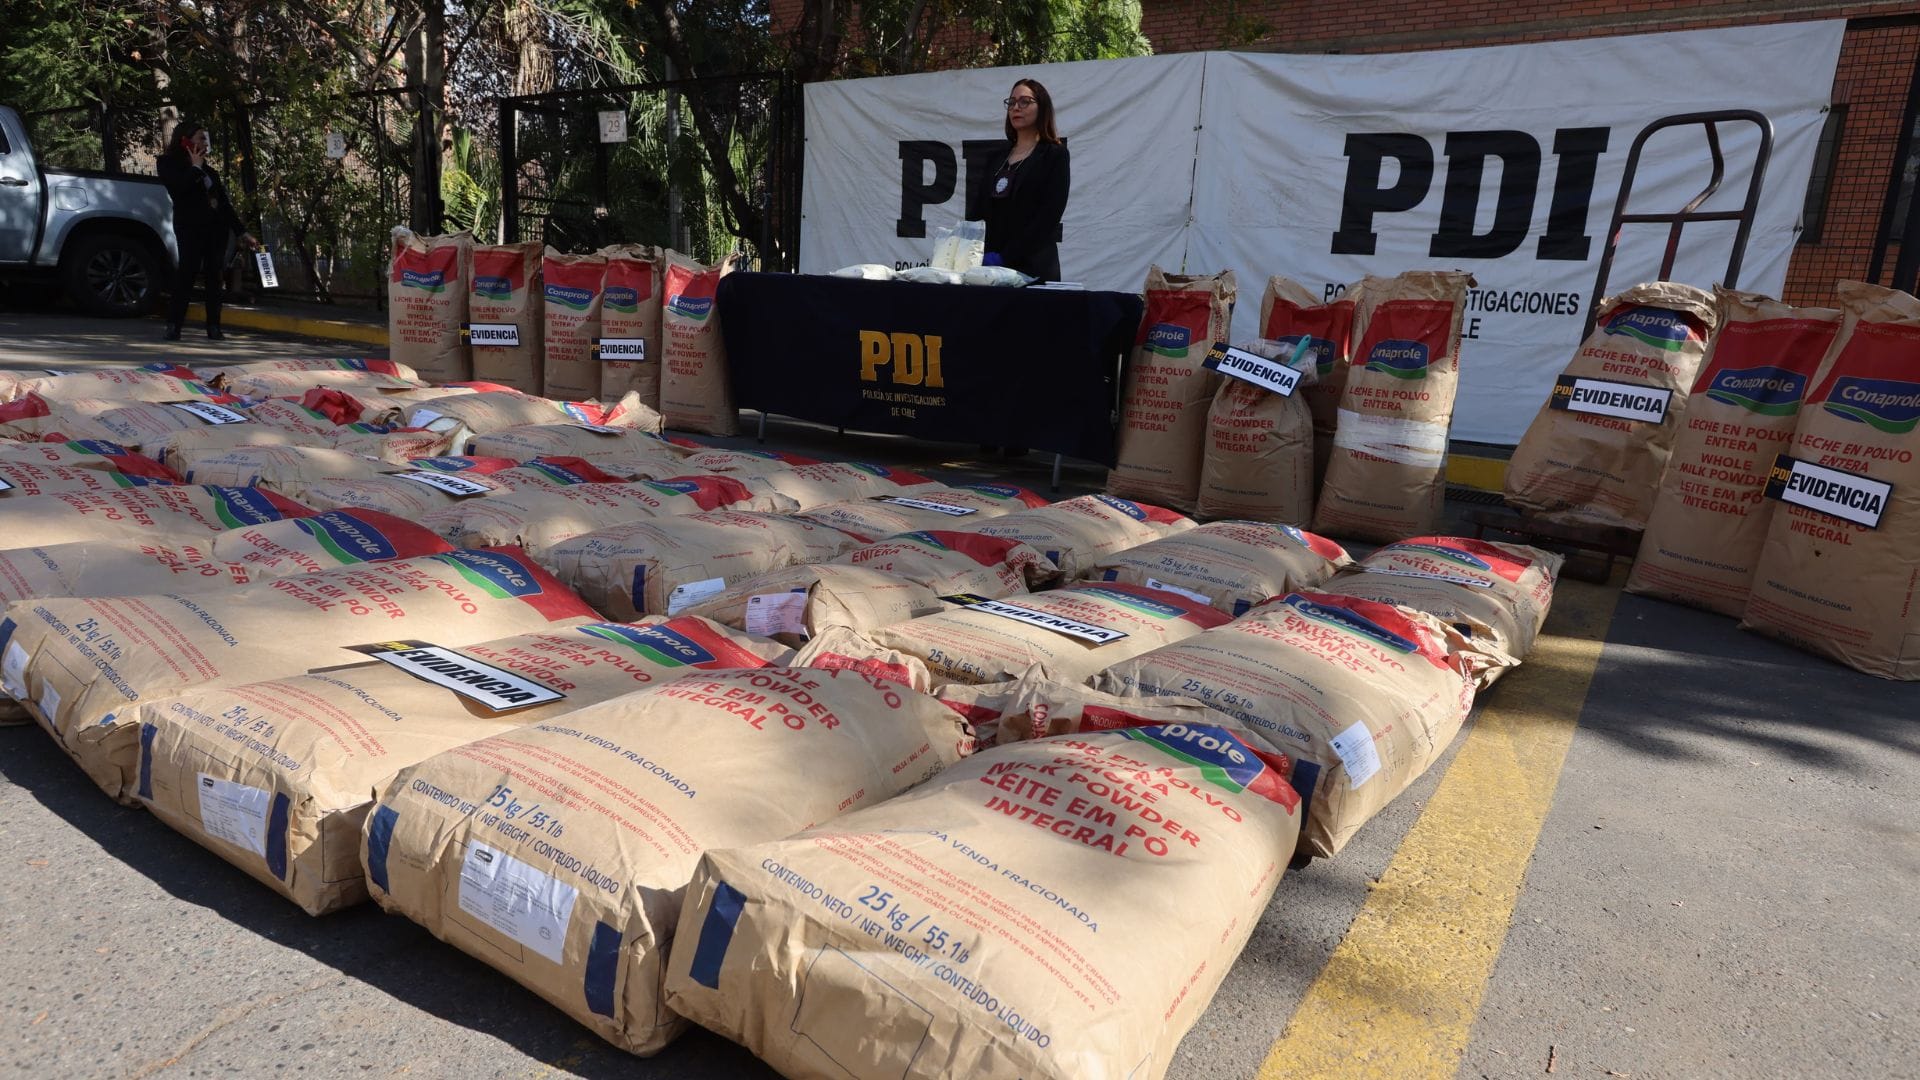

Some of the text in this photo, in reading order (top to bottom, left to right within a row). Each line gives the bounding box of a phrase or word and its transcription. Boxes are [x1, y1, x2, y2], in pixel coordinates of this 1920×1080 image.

[608, 119, 620, 132] 29
[1330, 126, 1610, 260] PDI
[260, 253, 276, 285] EVIDENCIA
[548, 287, 590, 300] Conaprole
[407, 313, 433, 321] WHOLE
[403, 336, 437, 344] INTEGRAL
[471, 330, 517, 340] EVIDENCIA
[600, 344, 643, 354] EVIDENCIA
[859, 329, 945, 389] PDI
[1583, 348, 1681, 376] LECHE EN POLVO
[1160, 367, 1193, 378] POLVO
[1222, 354, 1294, 389] EVIDENCIA
[1602, 362, 1649, 379] ENTERA
[1375, 388, 1389, 398] EN
[1392, 390, 1430, 401] POLVO
[1720, 375, 1796, 393] Conaprole
[1143, 400, 1184, 410] POWDER
[1362, 399, 1402, 411] ENTERA
[1554, 383, 1663, 414] PDI EVIDENCIA
[891, 407, 917, 419] DE CHILE
[1146, 413, 1160, 422] EM
[1575, 414, 1633, 433] INTEGRAL
[1232, 433, 1249, 442] EM
[1688, 419, 1741, 436] LECHE EN
[1704, 435, 1758, 453] ENTERA
[1798, 433, 1912, 464] LECHE EN POLVO
[1701, 452, 1752, 470] WHOLE
[1818, 454, 1870, 473] ENTERA
[1680, 463, 1767, 487] MILK POWDE
[628, 489, 661, 508] POLVO
[1680, 480, 1736, 500] LEITE EM
[1771, 466, 1882, 515] PDI EVIDENCIA
[1683, 495, 1748, 517] INTEGRAL
[241, 530, 280, 553] LECHE
[322, 512, 381, 555] Conaprole
[1790, 519, 1853, 546] INTEGRAL
[453, 551, 527, 589] Conaprole
[1160, 556, 1174, 566] 25
[348, 570, 405, 596] WHOLE
[316, 584, 374, 616] EM PÓ
[338, 576, 406, 620] POWDER
[429, 579, 478, 615] POLVO
[978, 601, 1111, 640] EVIDENCIA
[1043, 603, 1106, 625] WHOLE
[1109, 608, 1166, 633] POLVO
[75, 618, 100, 643] 25 kg
[505, 648, 571, 671] WHOLE
[531, 642, 596, 668] ENTERA
[593, 649, 653, 684] POLVO
[927, 648, 943, 663] 25
[394, 648, 538, 704] EVIDENCIA
[500, 654, 577, 692] POWDER
[736, 671, 841, 731] POWDER
[1181, 678, 1200, 692] 25
[1200, 685, 1214, 699] kg
[223, 706, 249, 728] 25 kg
[655, 689, 768, 731] INTEGRAL
[723, 687, 806, 731] EM PÓ
[1235, 711, 1312, 743] CONTEÚDO LÍQUIDO
[583, 733, 622, 755] VENDA
[620, 750, 697, 799] FRACIONADA
[1053, 757, 1159, 804] WHOLE
[1109, 754, 1243, 823] EN POLVO
[485, 784, 512, 808] 25
[505, 798, 523, 820] kg
[980, 773, 1169, 857] LEITE EM PÓ
[1066, 773, 1202, 847] POWDER
[411, 778, 620, 895] CONTENIDO NET WEIGHT CONTEÚDO LÍQUIDO
[984, 796, 1130, 858] INTEGRAL
[952, 840, 1100, 933] VENDA FRACIONADA
[859, 885, 894, 912] 25
[886, 905, 911, 932] kg
[761, 859, 1052, 1049] CONTENIDO NETO NET WEIGHT CONTEÚDO LÍQUIDO
